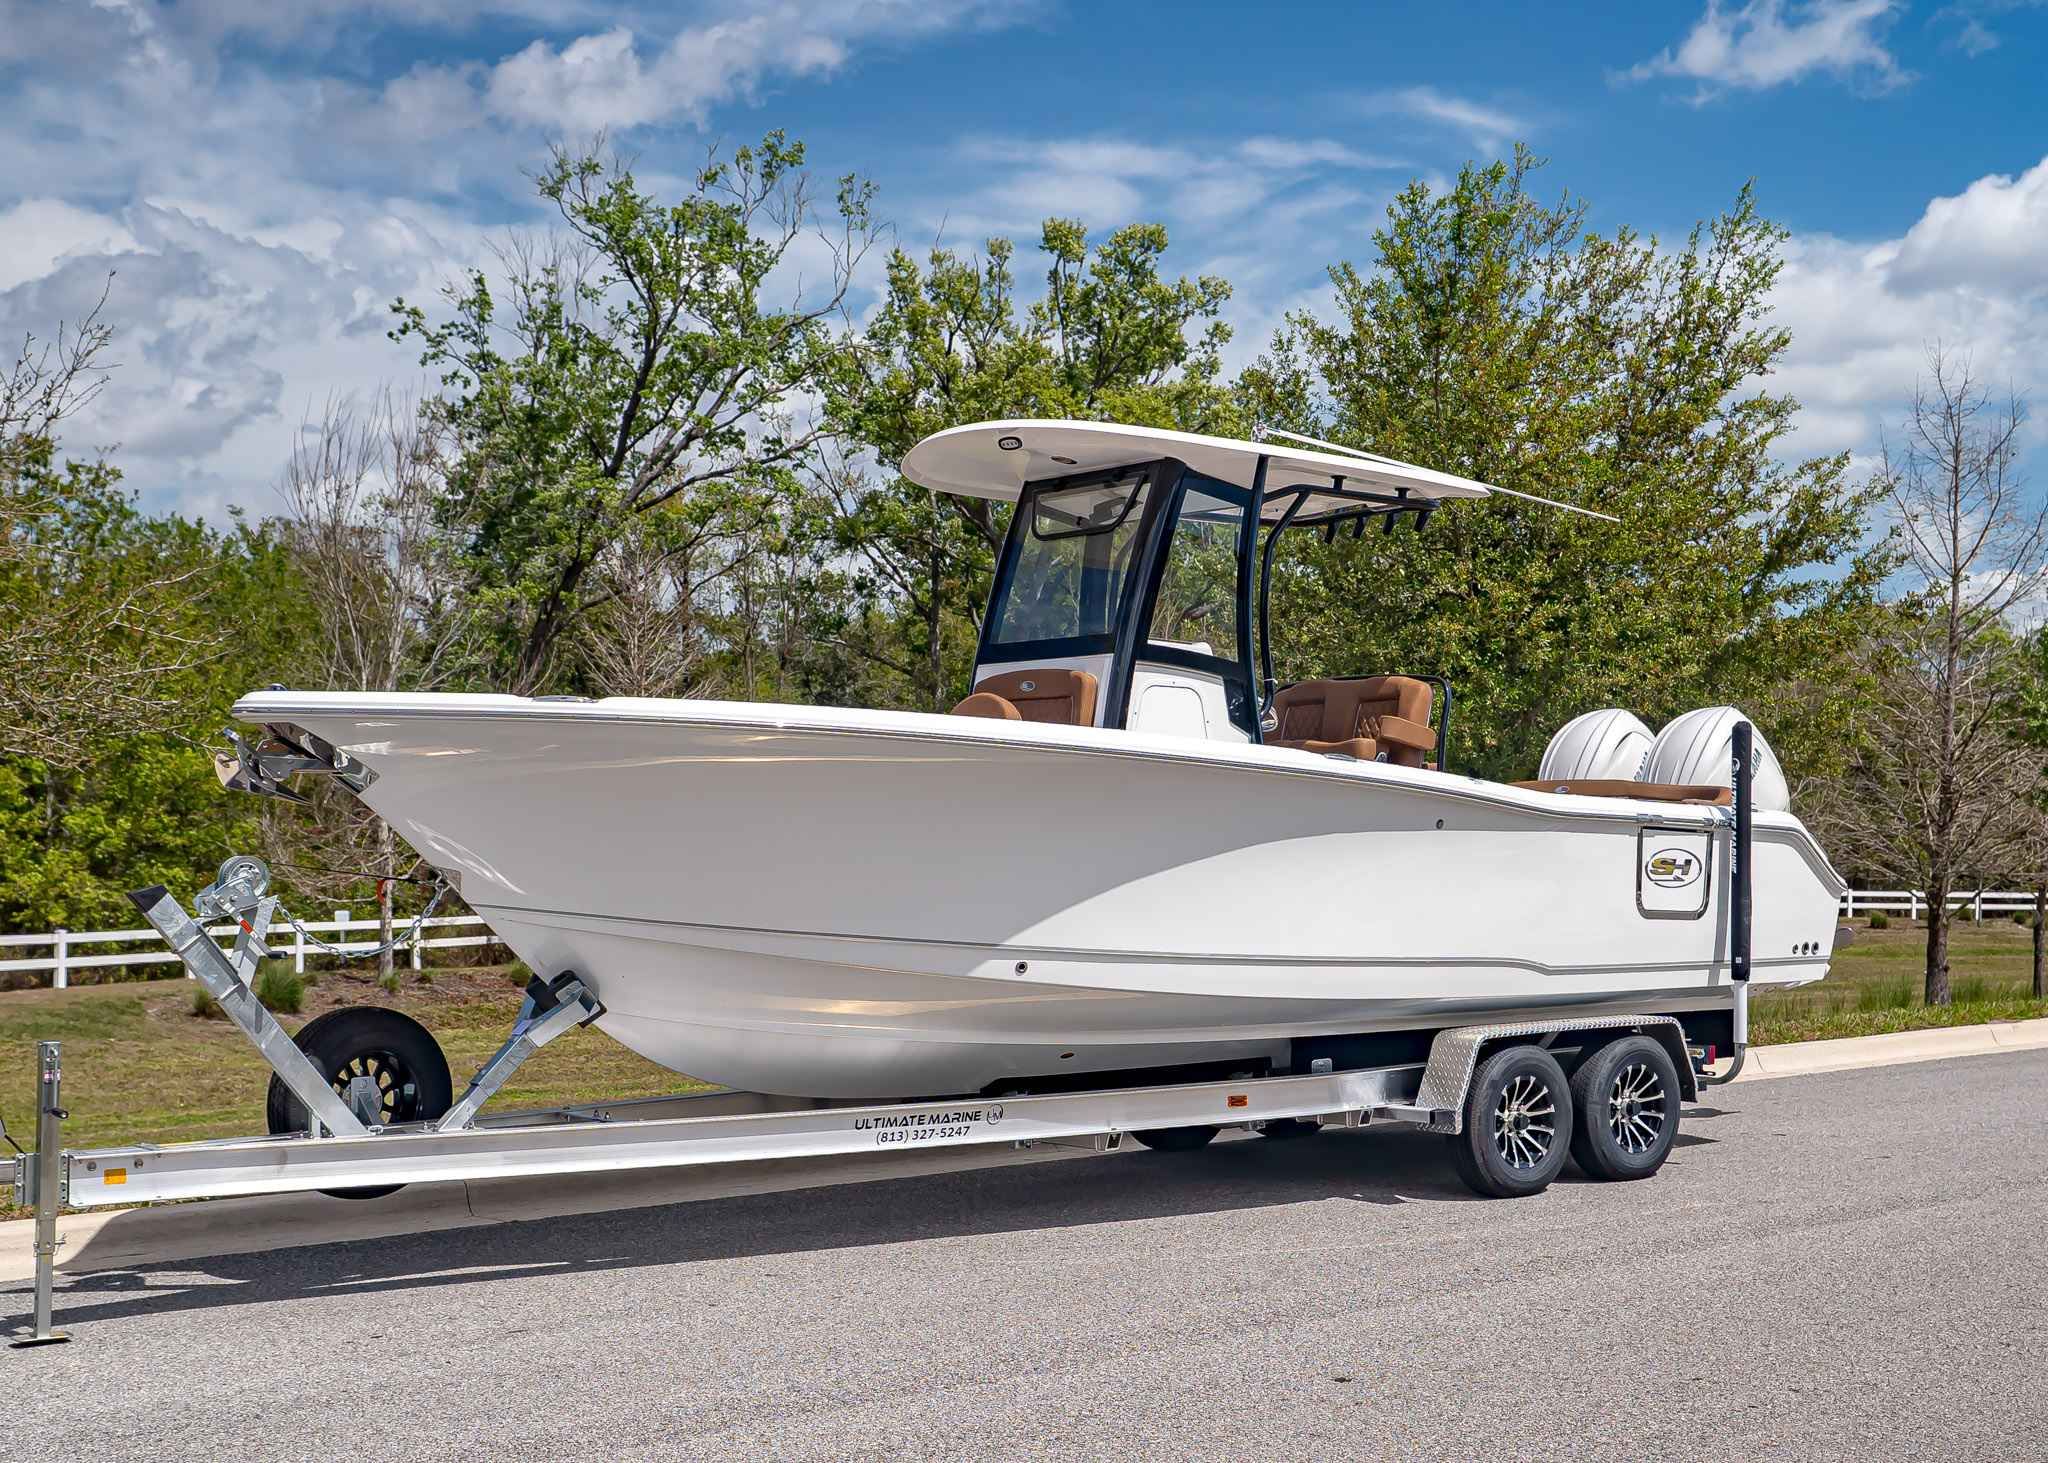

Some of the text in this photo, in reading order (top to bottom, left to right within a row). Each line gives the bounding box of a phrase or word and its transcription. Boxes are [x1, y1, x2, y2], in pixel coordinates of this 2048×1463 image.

[854, 1115, 926, 1130] ULTIMATE
[927, 1110, 982, 1125] MARINE
[876, 1126, 971, 1146] (813) 327-5247
